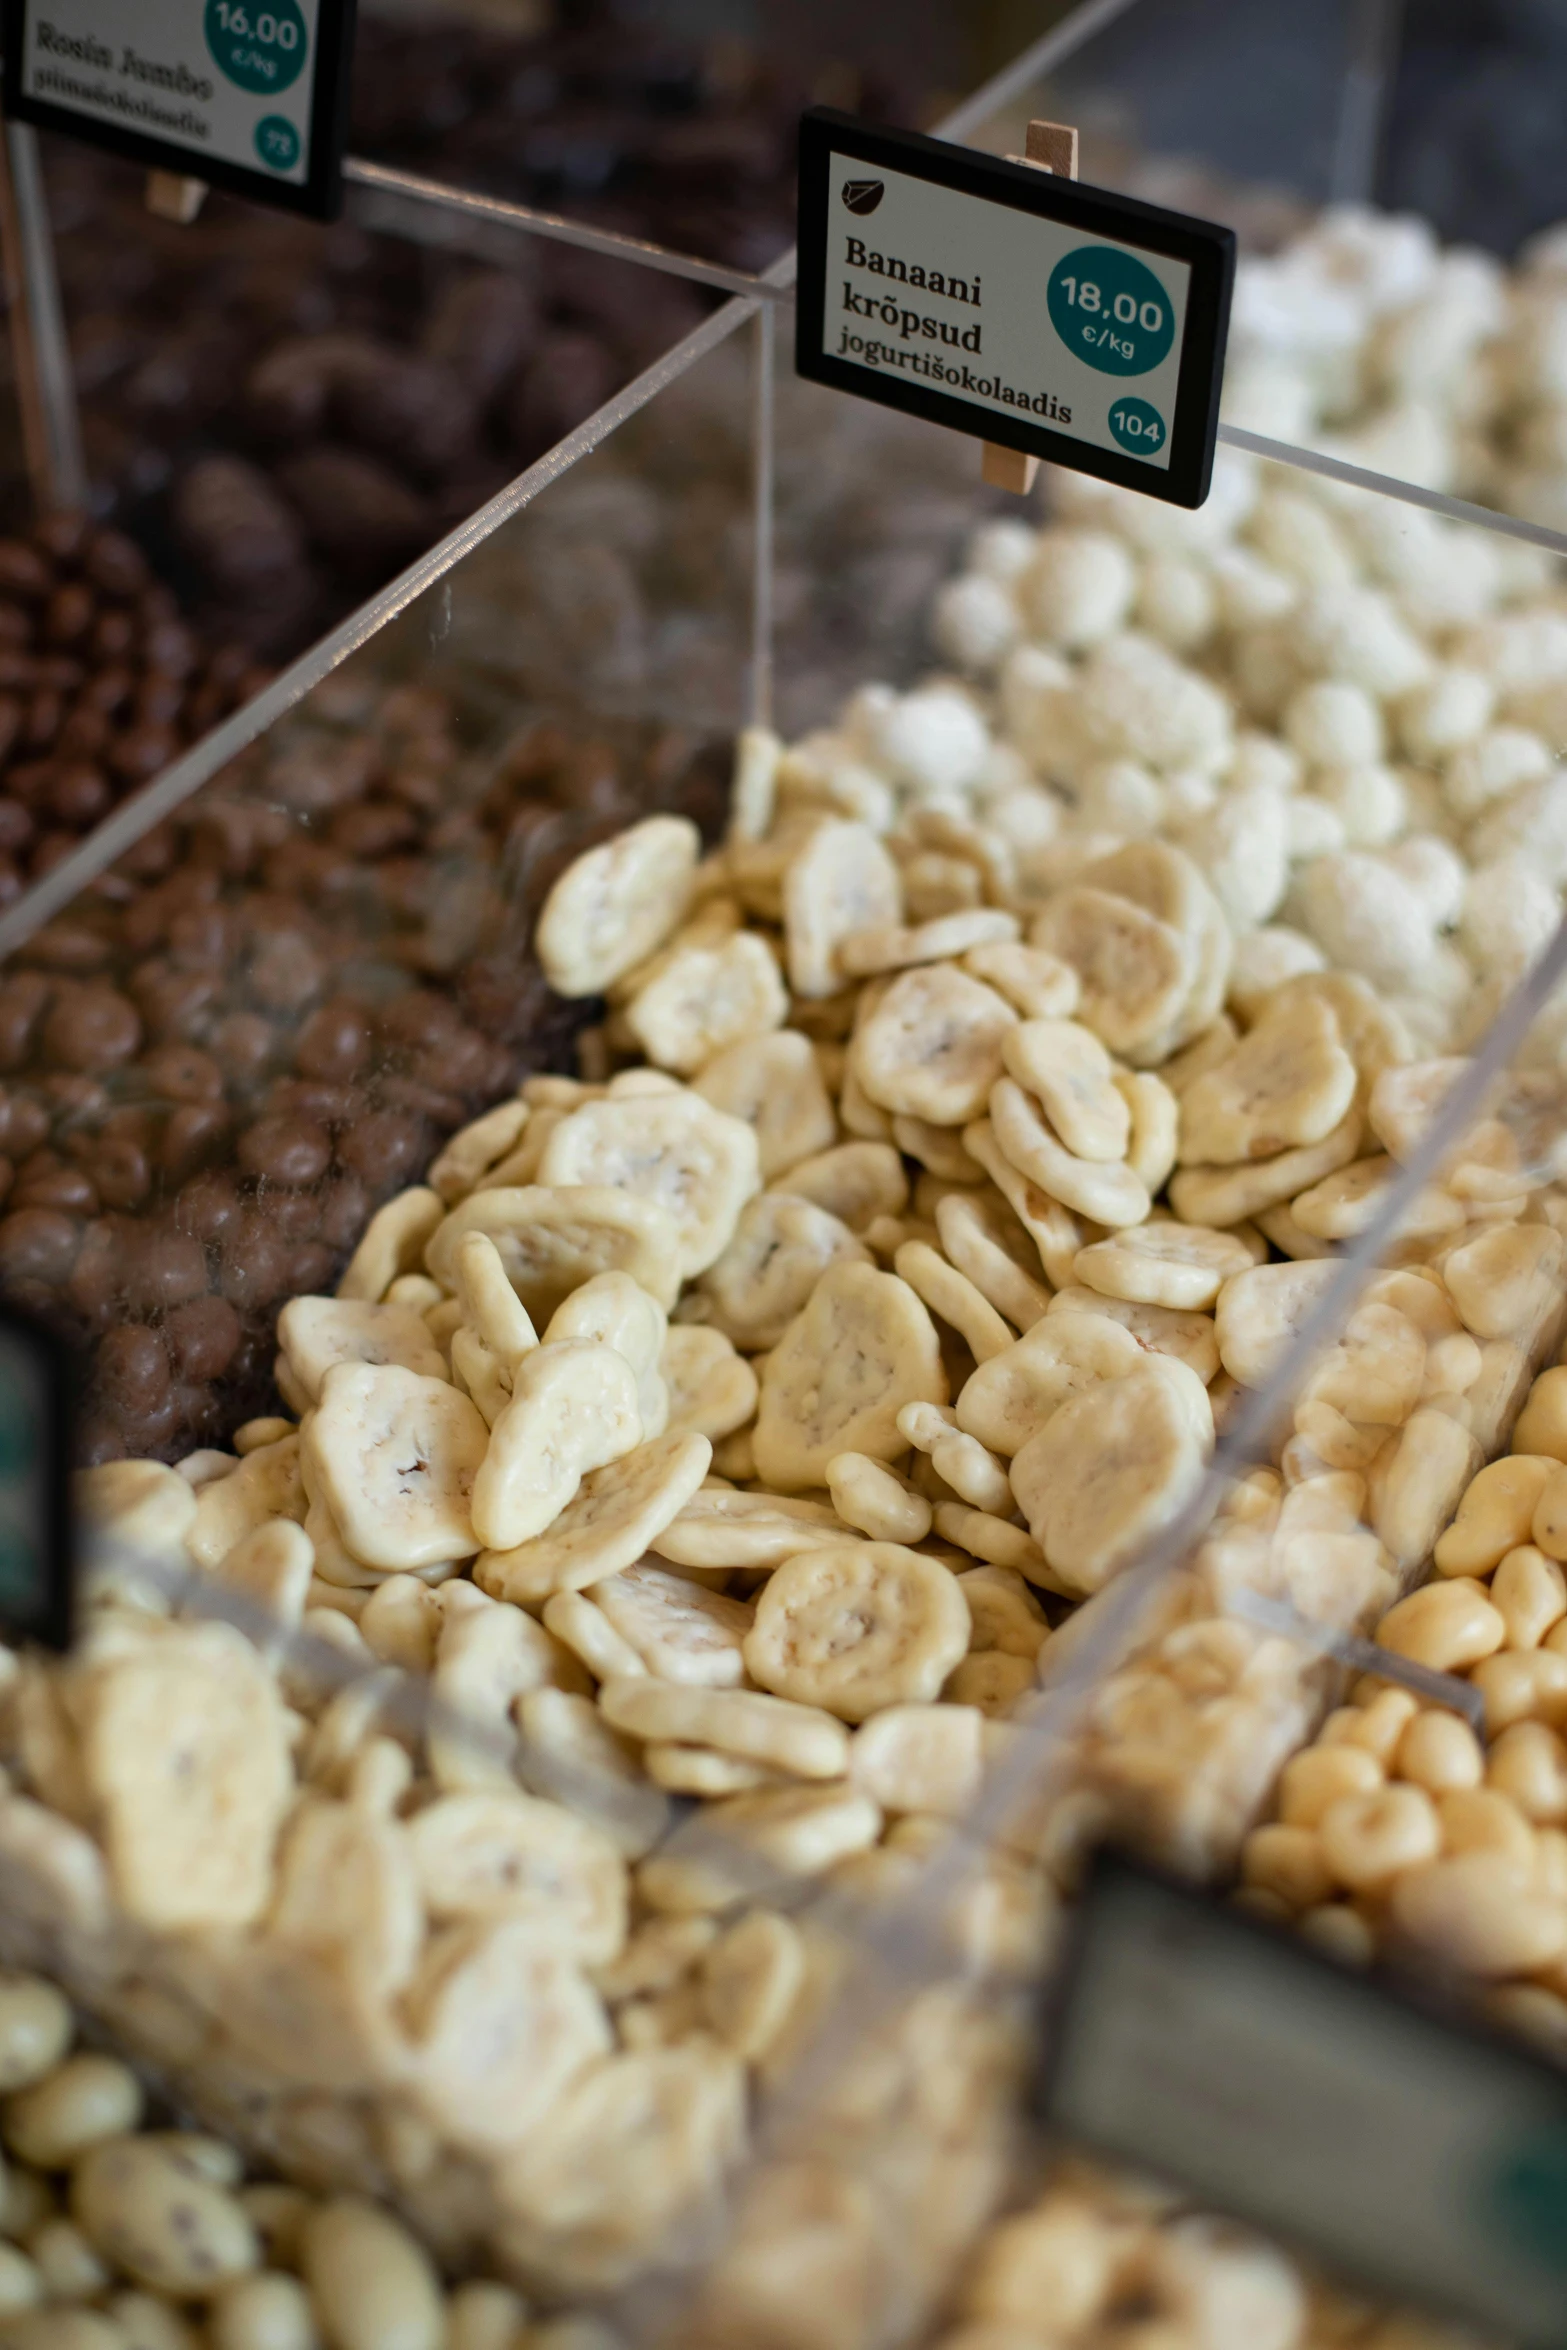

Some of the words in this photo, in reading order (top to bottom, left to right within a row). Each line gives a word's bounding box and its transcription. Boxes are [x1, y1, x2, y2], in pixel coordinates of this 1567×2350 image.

[120, 46, 214, 102] Jumbo
[845, 237, 982, 307] Banaani
[842, 282, 982, 354] krõpsud
[1060, 276, 1163, 333] 18,00
[1081, 326, 1136, 360] €/kg
[837, 327, 1073, 425] jogurtišokolaadis
[1113, 411, 1160, 443] 104
